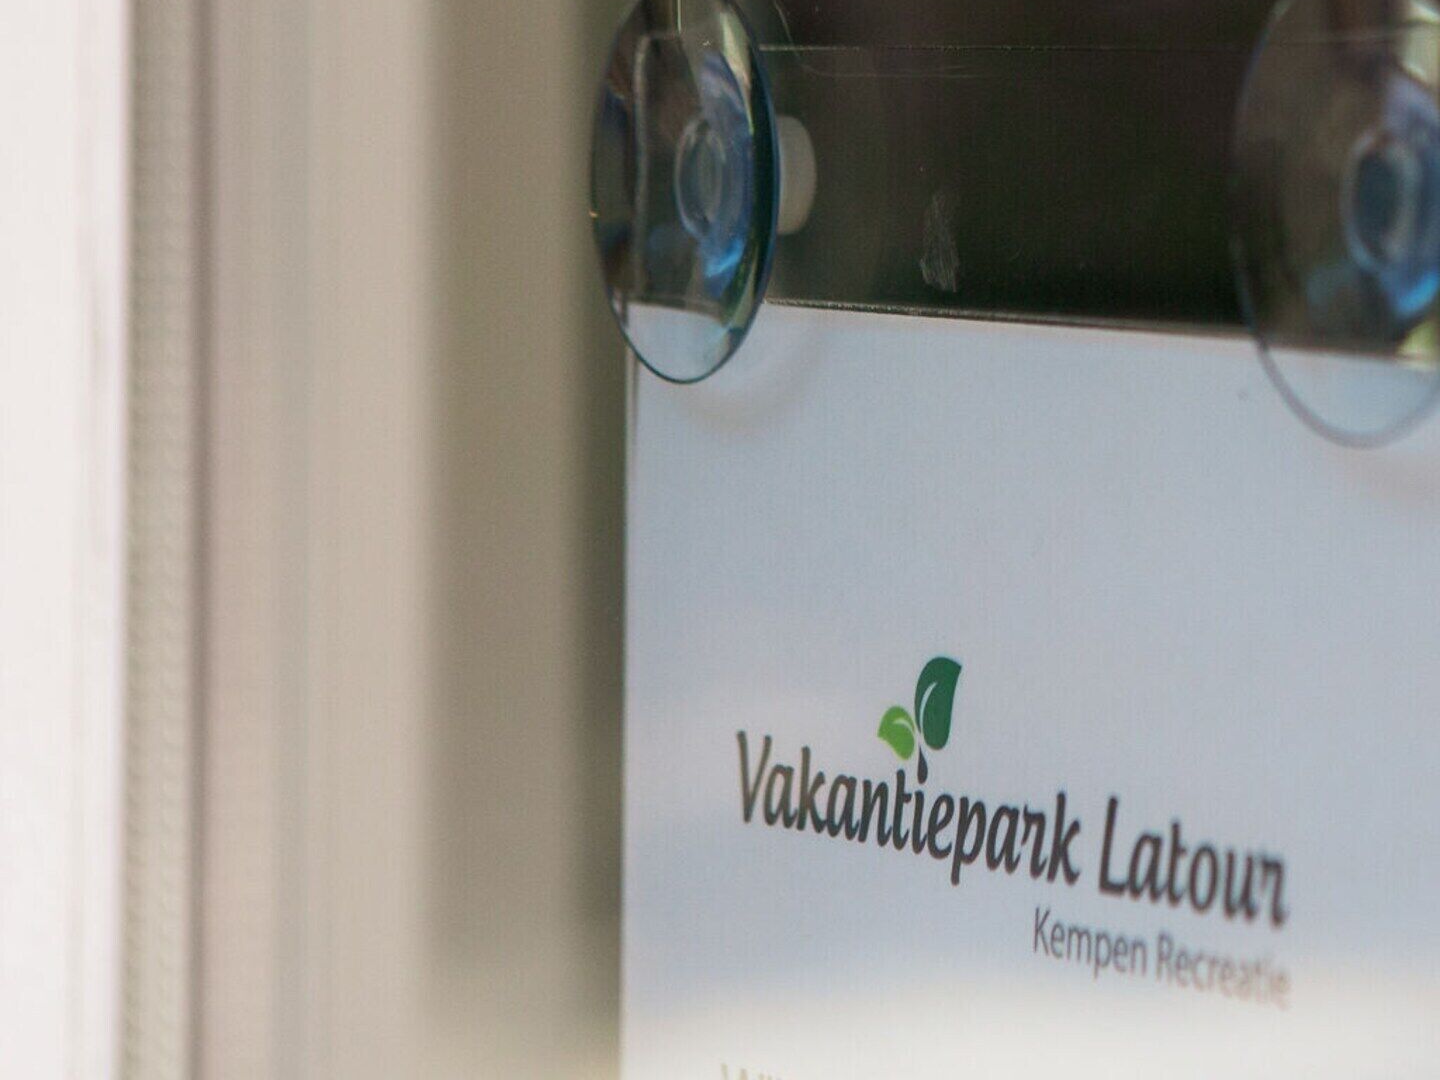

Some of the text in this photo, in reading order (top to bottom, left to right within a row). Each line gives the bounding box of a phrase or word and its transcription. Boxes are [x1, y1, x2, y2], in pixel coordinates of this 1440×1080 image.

[735, 730, 1291, 929] Vakantiepark Latour
[1033, 905, 1292, 1010] Kempen Recreatie
